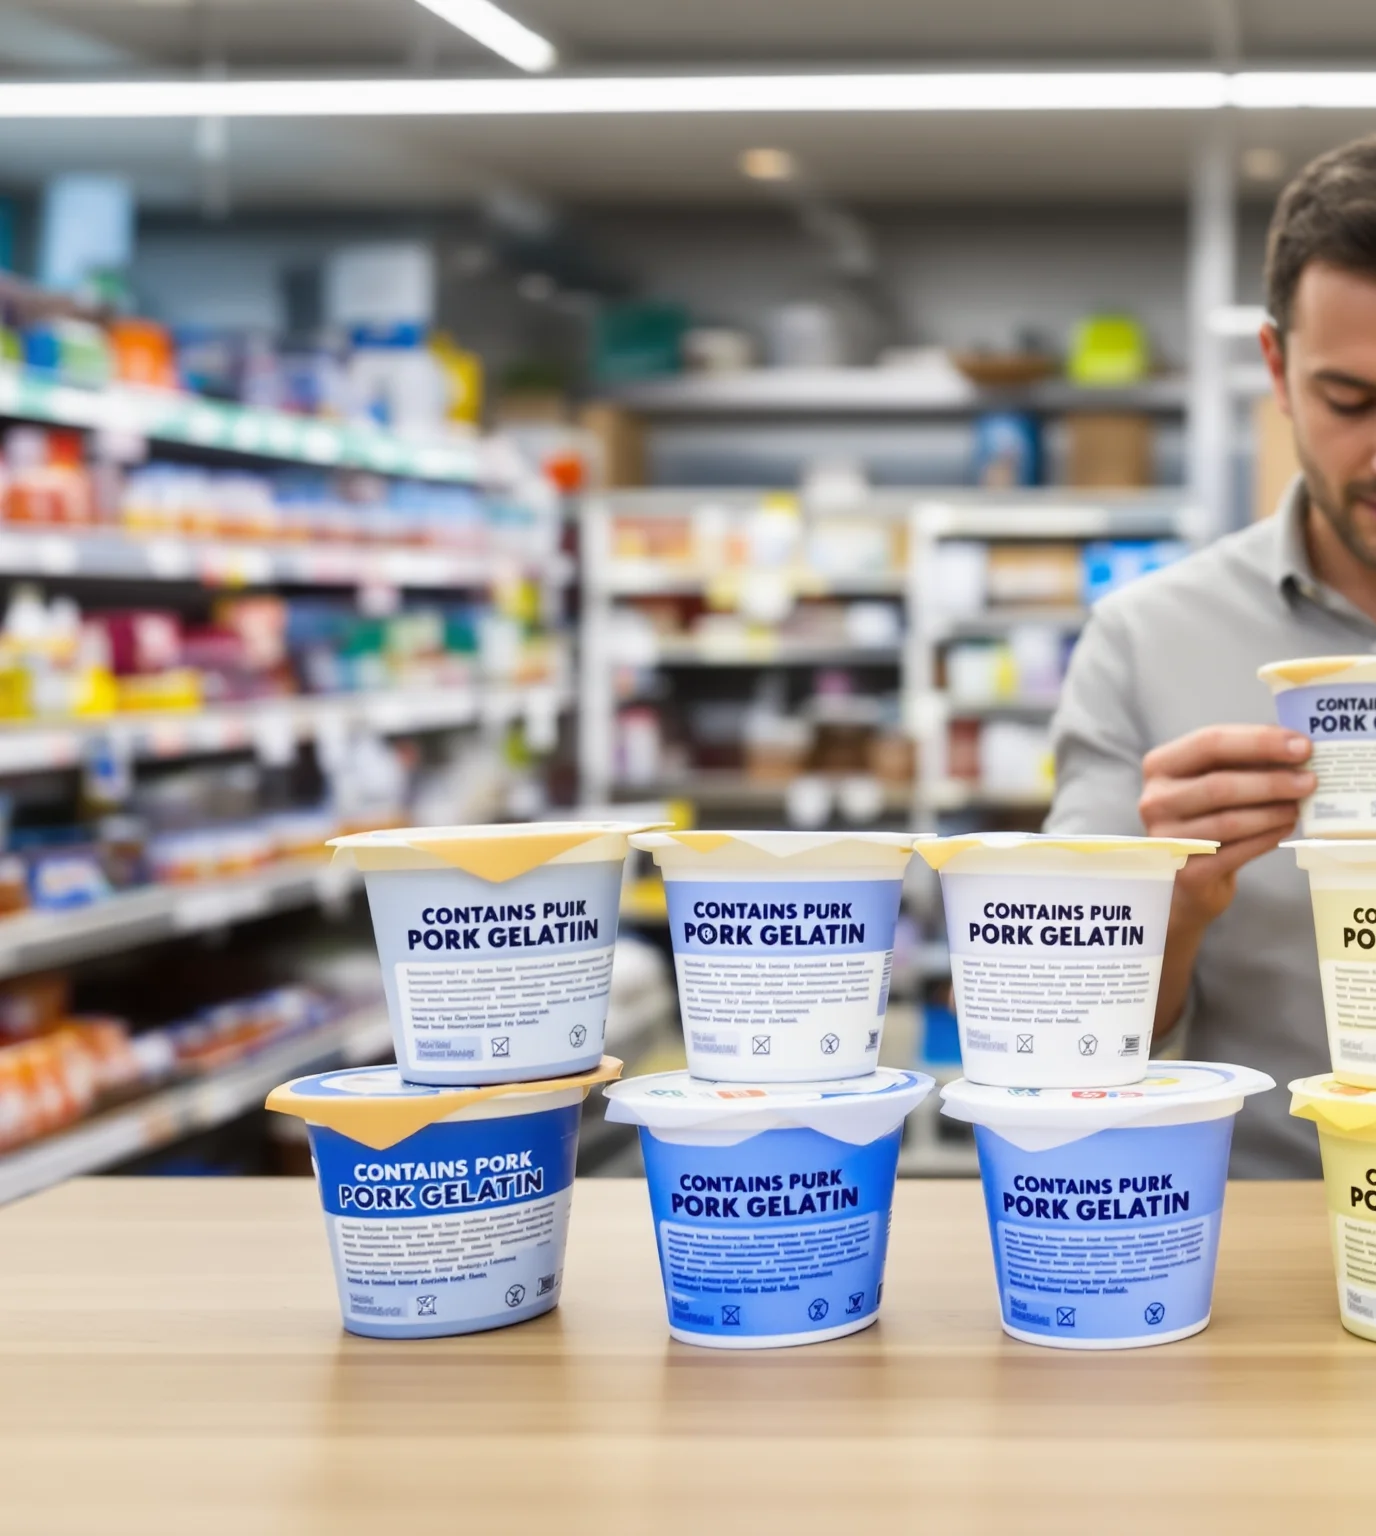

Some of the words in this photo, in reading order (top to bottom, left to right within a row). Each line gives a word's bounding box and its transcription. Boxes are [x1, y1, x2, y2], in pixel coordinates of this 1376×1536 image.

[1309, 715, 1367, 734] PORK
[422, 904, 536, 925] CONTAINS
[694, 902, 797, 919] CONTAINS
[984, 902, 1084, 920] CONTAINS
[408, 928, 480, 950] PORK
[684, 923, 753, 945] PORK
[760, 923, 865, 945] GELATIN
[970, 923, 1033, 945] PORK
[1040, 926, 1143, 946] GELATIN
[354, 1159, 468, 1182] CONTAINS
[475, 1150, 533, 1175] PORK
[339, 1184, 416, 1210] PORK
[420, 1167, 543, 1208] GELATIN
[680, 1174, 783, 1193] CONTAINS
[1014, 1175, 1113, 1195] CONTAINS
[672, 1193, 740, 1217] PORK
[747, 1186, 858, 1217] GELATIN
[1003, 1192, 1070, 1220] PORK
[1076, 1191, 1189, 1221] GELATIN
